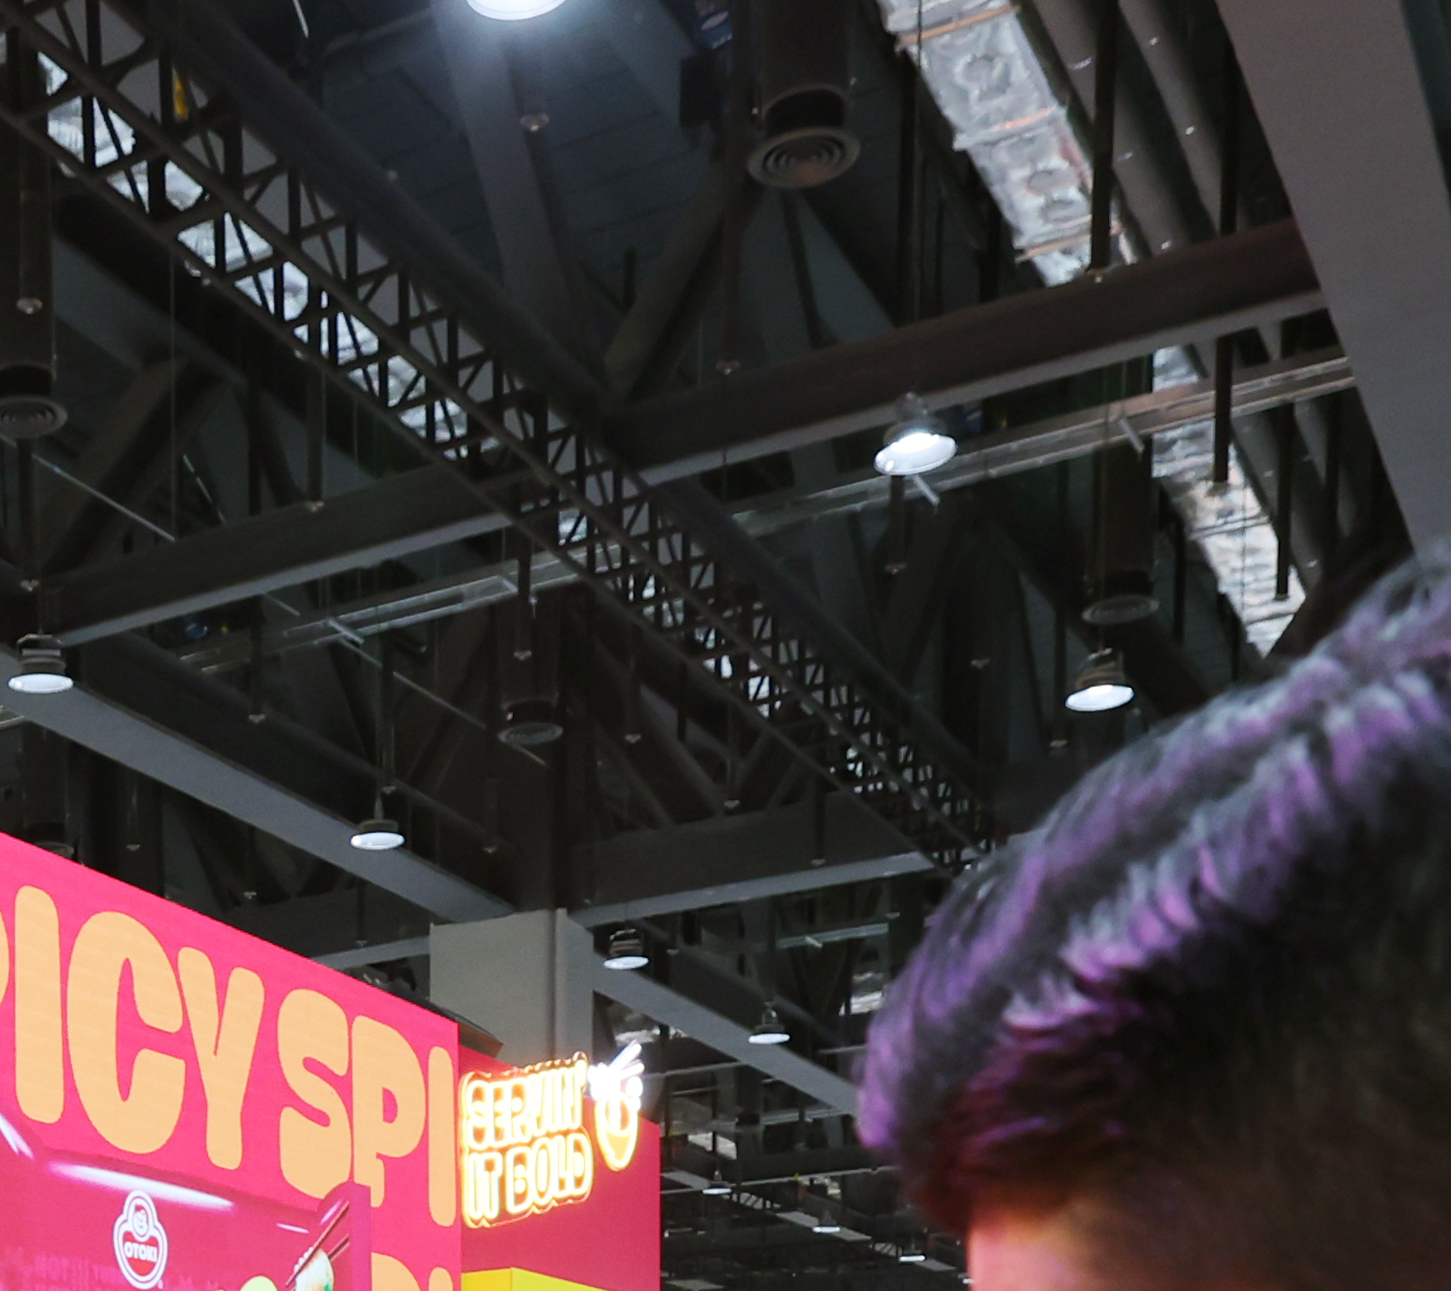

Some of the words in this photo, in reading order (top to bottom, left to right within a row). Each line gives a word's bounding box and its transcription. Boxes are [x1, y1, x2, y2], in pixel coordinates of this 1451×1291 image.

[467, 1151, 503, 1219] IT
[505, 1133, 593, 1214] BOLD
[124, 1241, 158, 1261] OTOKI
